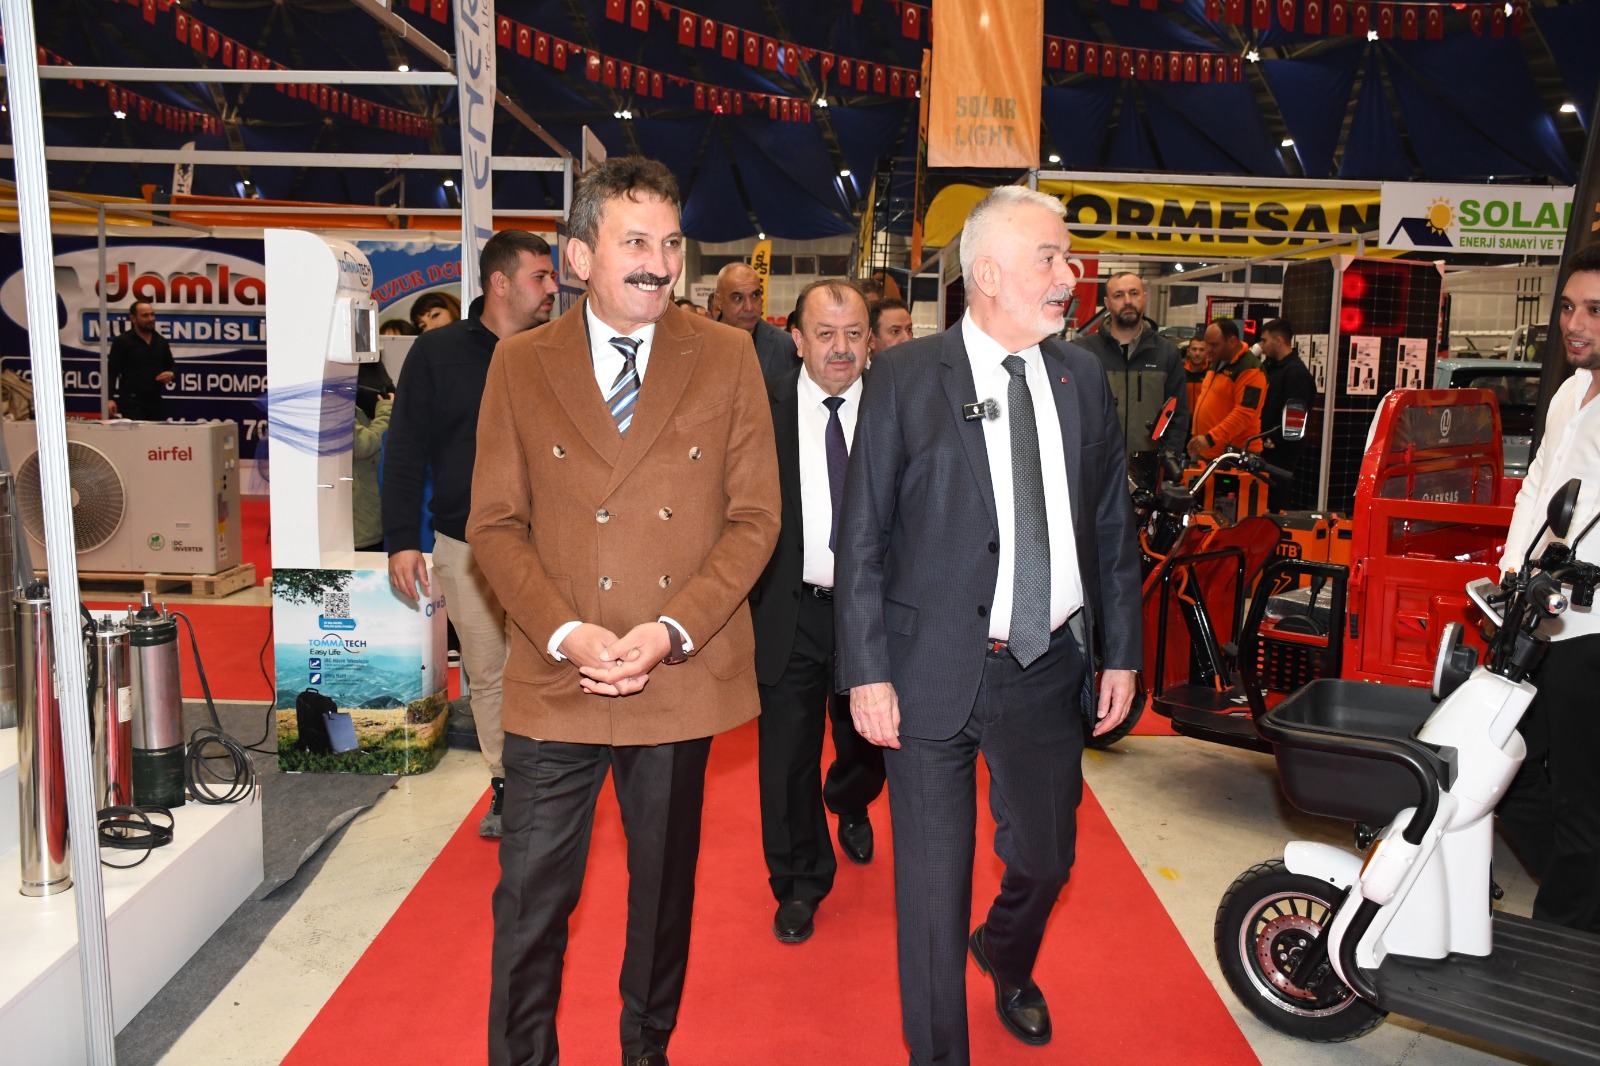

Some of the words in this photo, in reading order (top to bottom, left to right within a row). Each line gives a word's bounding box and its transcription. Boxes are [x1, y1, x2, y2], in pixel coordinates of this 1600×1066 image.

[956, 96, 1017, 119] SOLAR
[955, 124, 1015, 146] LIGHT
[1050, 193, 1380, 247] ORMESAN
[1459, 235, 1496, 249] ENERJİ
[1499, 237, 1537, 250] SANAYİ
[1540, 239, 1554, 250] VE
[88, 317, 267, 342] MÜENDİSLİ
[181, 373, 202, 392] ISI
[147, 446, 192, 461] airfel
